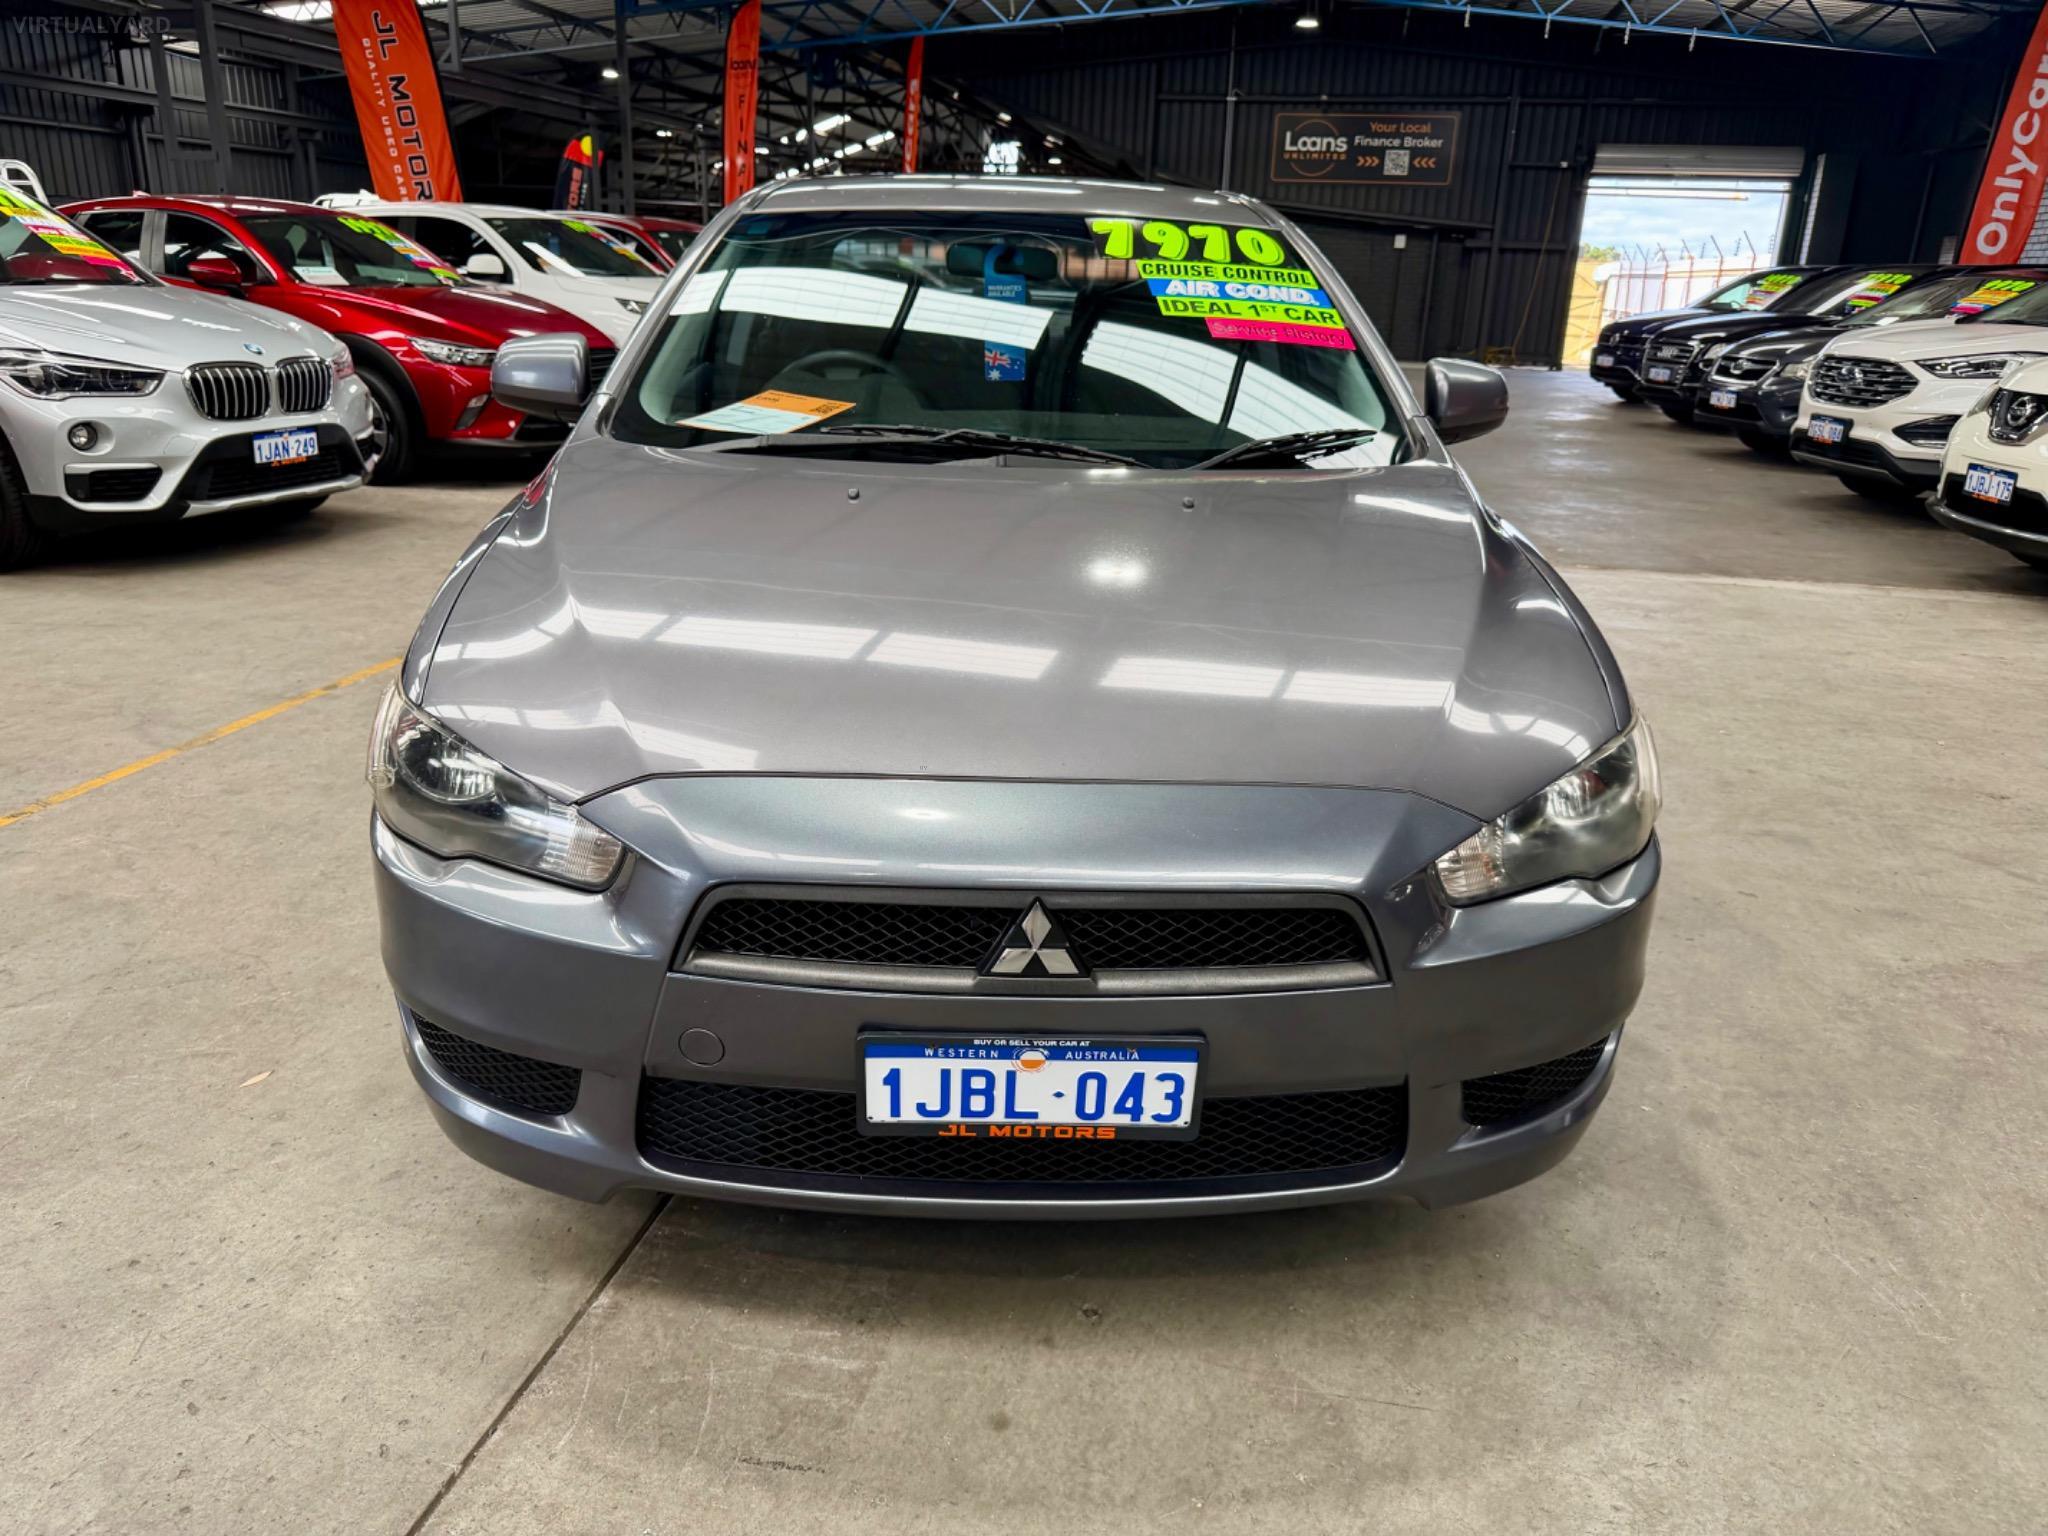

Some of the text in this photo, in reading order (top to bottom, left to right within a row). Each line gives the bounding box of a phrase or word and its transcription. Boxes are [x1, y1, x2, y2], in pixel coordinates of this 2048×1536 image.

[372, 10, 399, 61] JL
[362, 38, 387, 108] QUALITY
[381, 115, 398, 157] USED
[1370, 121, 1432, 133] Your Local
[1284, 131, 1348, 152] Loans
[1353, 135, 1444, 148] Finance Broker
[1976, 40, 2048, 256] OnlyCa
[1092, 220, 1285, 266] 7970
[1142, 262, 1313, 286] CRUISE CONTROL
[1165, 279, 1320, 305] AIR COND.
[1162, 299, 1339, 325] IDEAL 1ST CAR
[1213, 322, 1346, 346] Service History
[925, 1048, 1140, 1061] WESTERN AUSTRALIA
[938, 1124, 1117, 1139] JL MOTORS
